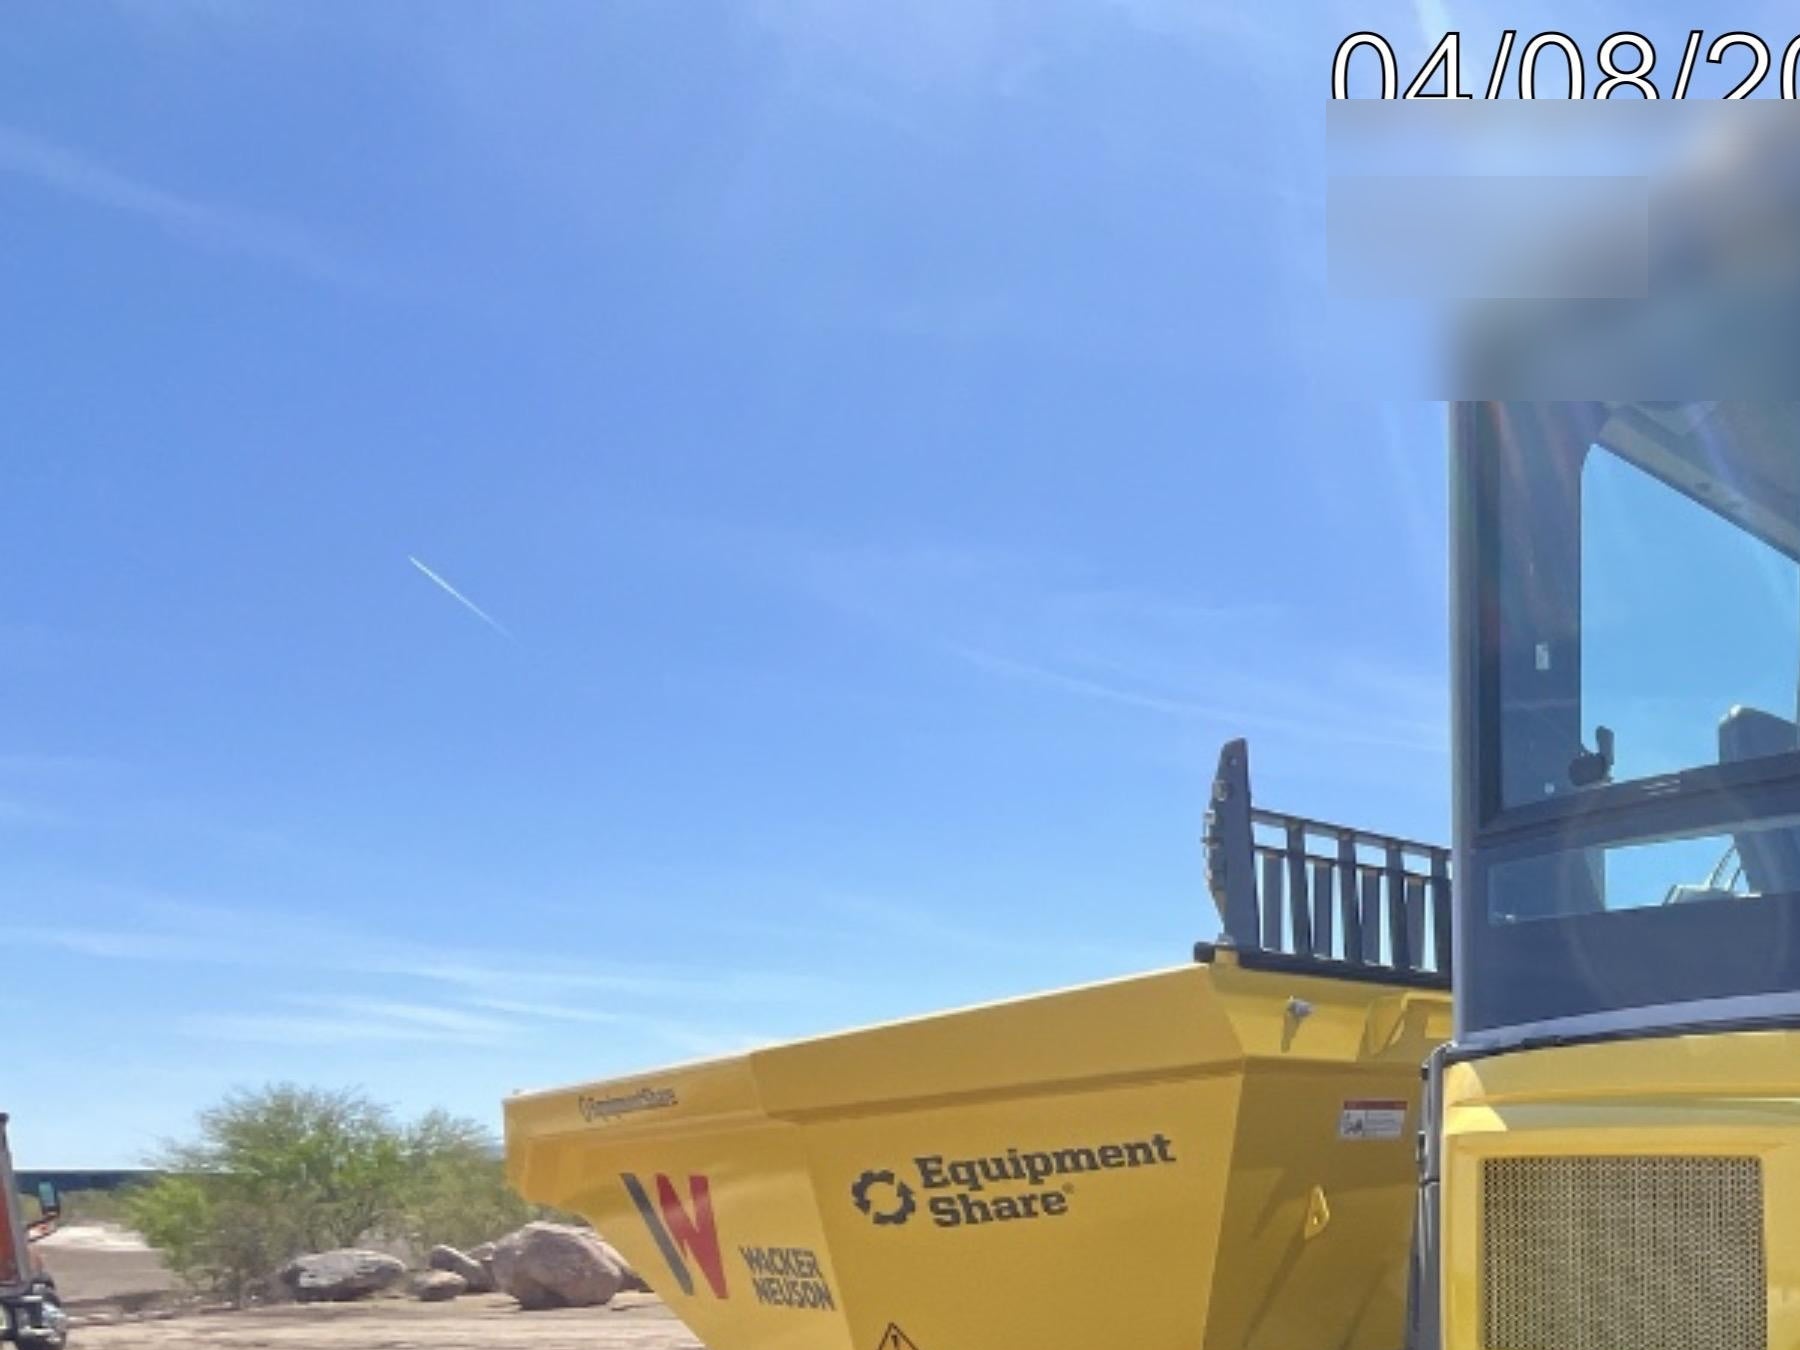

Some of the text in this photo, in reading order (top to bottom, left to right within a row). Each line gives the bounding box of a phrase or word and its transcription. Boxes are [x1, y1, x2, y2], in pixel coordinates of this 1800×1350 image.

[914, 1133, 1177, 1191] Equipment
[738, 1246, 824, 1278] WACKER
[752, 1276, 836, 1311] NEUSON
